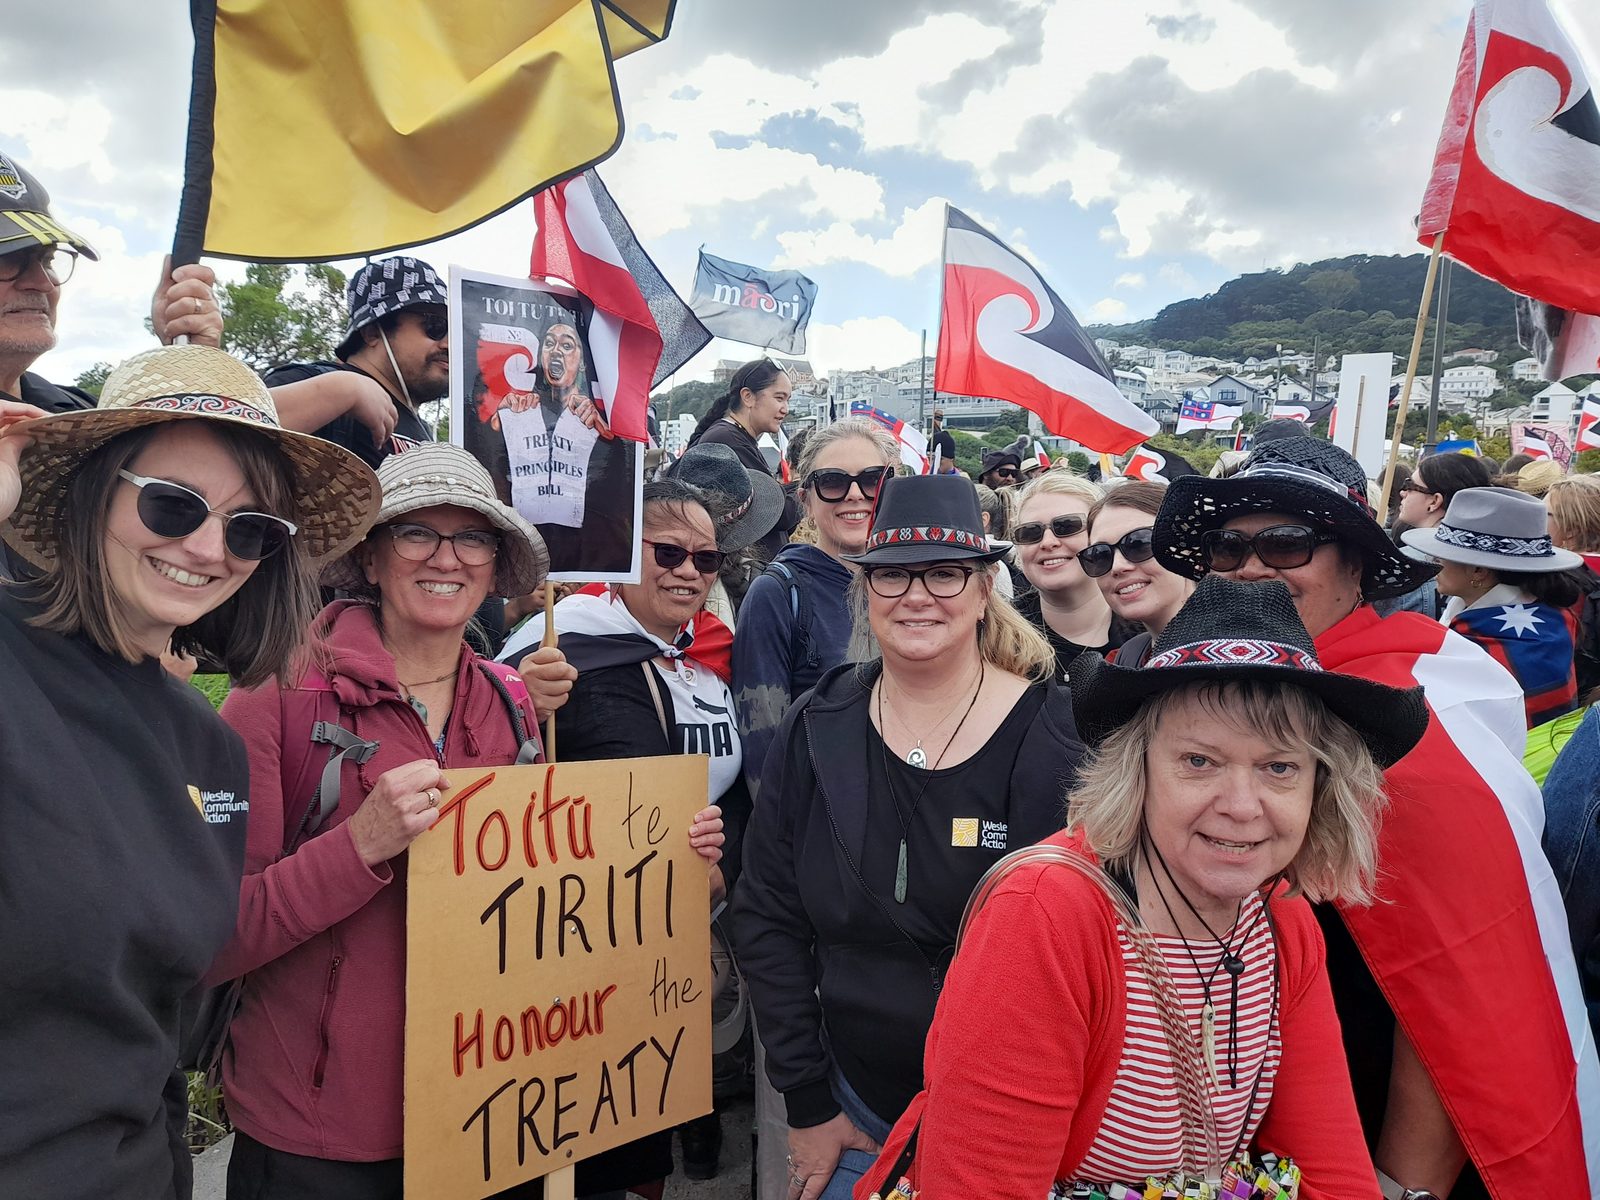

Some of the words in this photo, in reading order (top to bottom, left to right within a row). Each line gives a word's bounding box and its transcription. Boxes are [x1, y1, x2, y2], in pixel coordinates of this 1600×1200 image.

[712, 281, 800, 321] māori
[523, 433, 574, 452] TREATY
[515, 460, 583, 478] PRINCIPLES
[538, 484, 564, 497] BILL
[201, 790, 235, 803] Wesley
[427, 765, 595, 876] Toitū
[622, 771, 669, 850] te
[982, 820, 1008, 832] Wesle
[480, 850, 673, 975] TIRITI
[453, 983, 617, 1077] Honour
[649, 956, 702, 1017] the
[462, 1026, 685, 1182] TREATY
